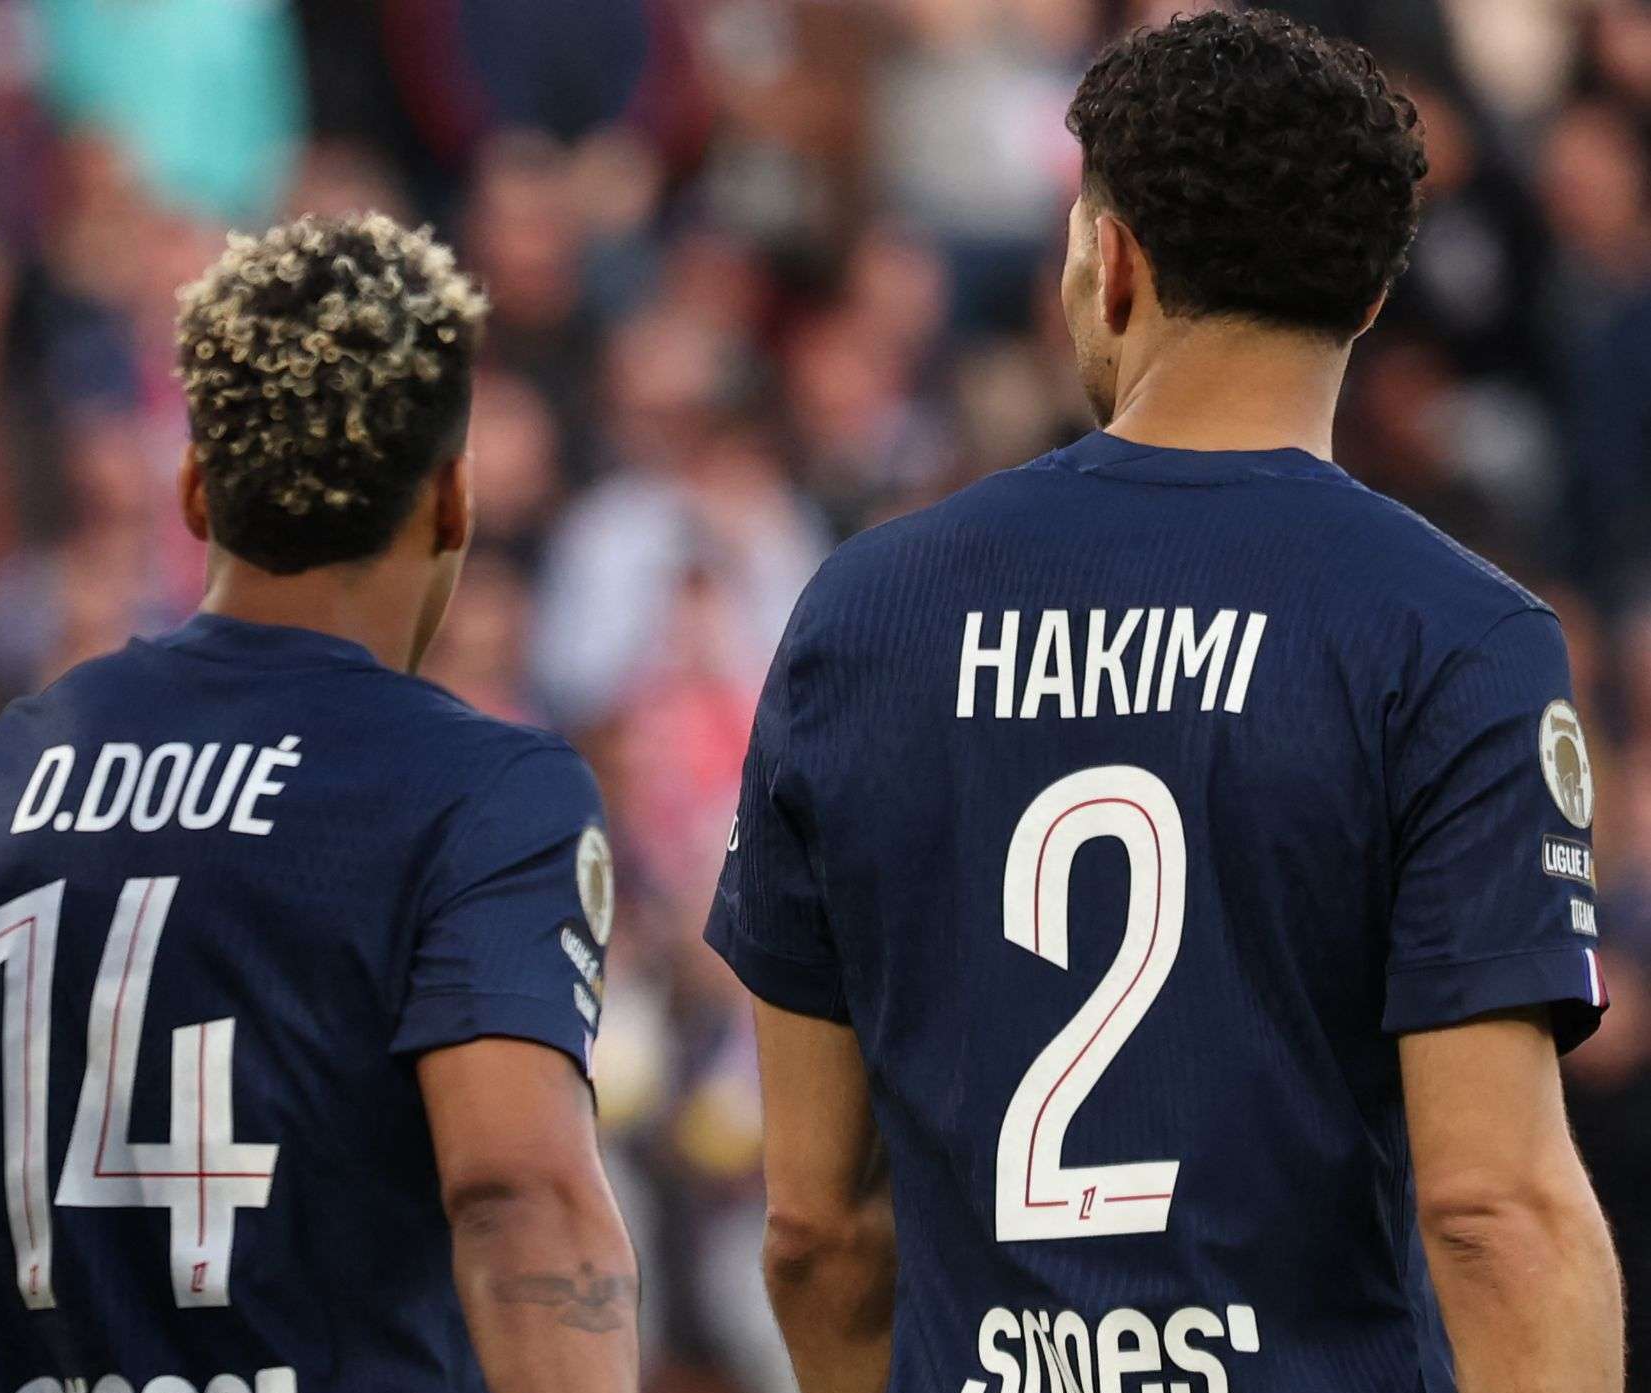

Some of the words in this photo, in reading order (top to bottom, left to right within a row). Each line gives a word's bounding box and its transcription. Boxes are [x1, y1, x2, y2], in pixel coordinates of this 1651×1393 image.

[956, 606, 1267, 719] HAKIMI
[10, 736, 302, 835] D.DOUÉ
[1546, 842, 1582, 877] LIGUE
[995, 764, 1186, 1243] 2
